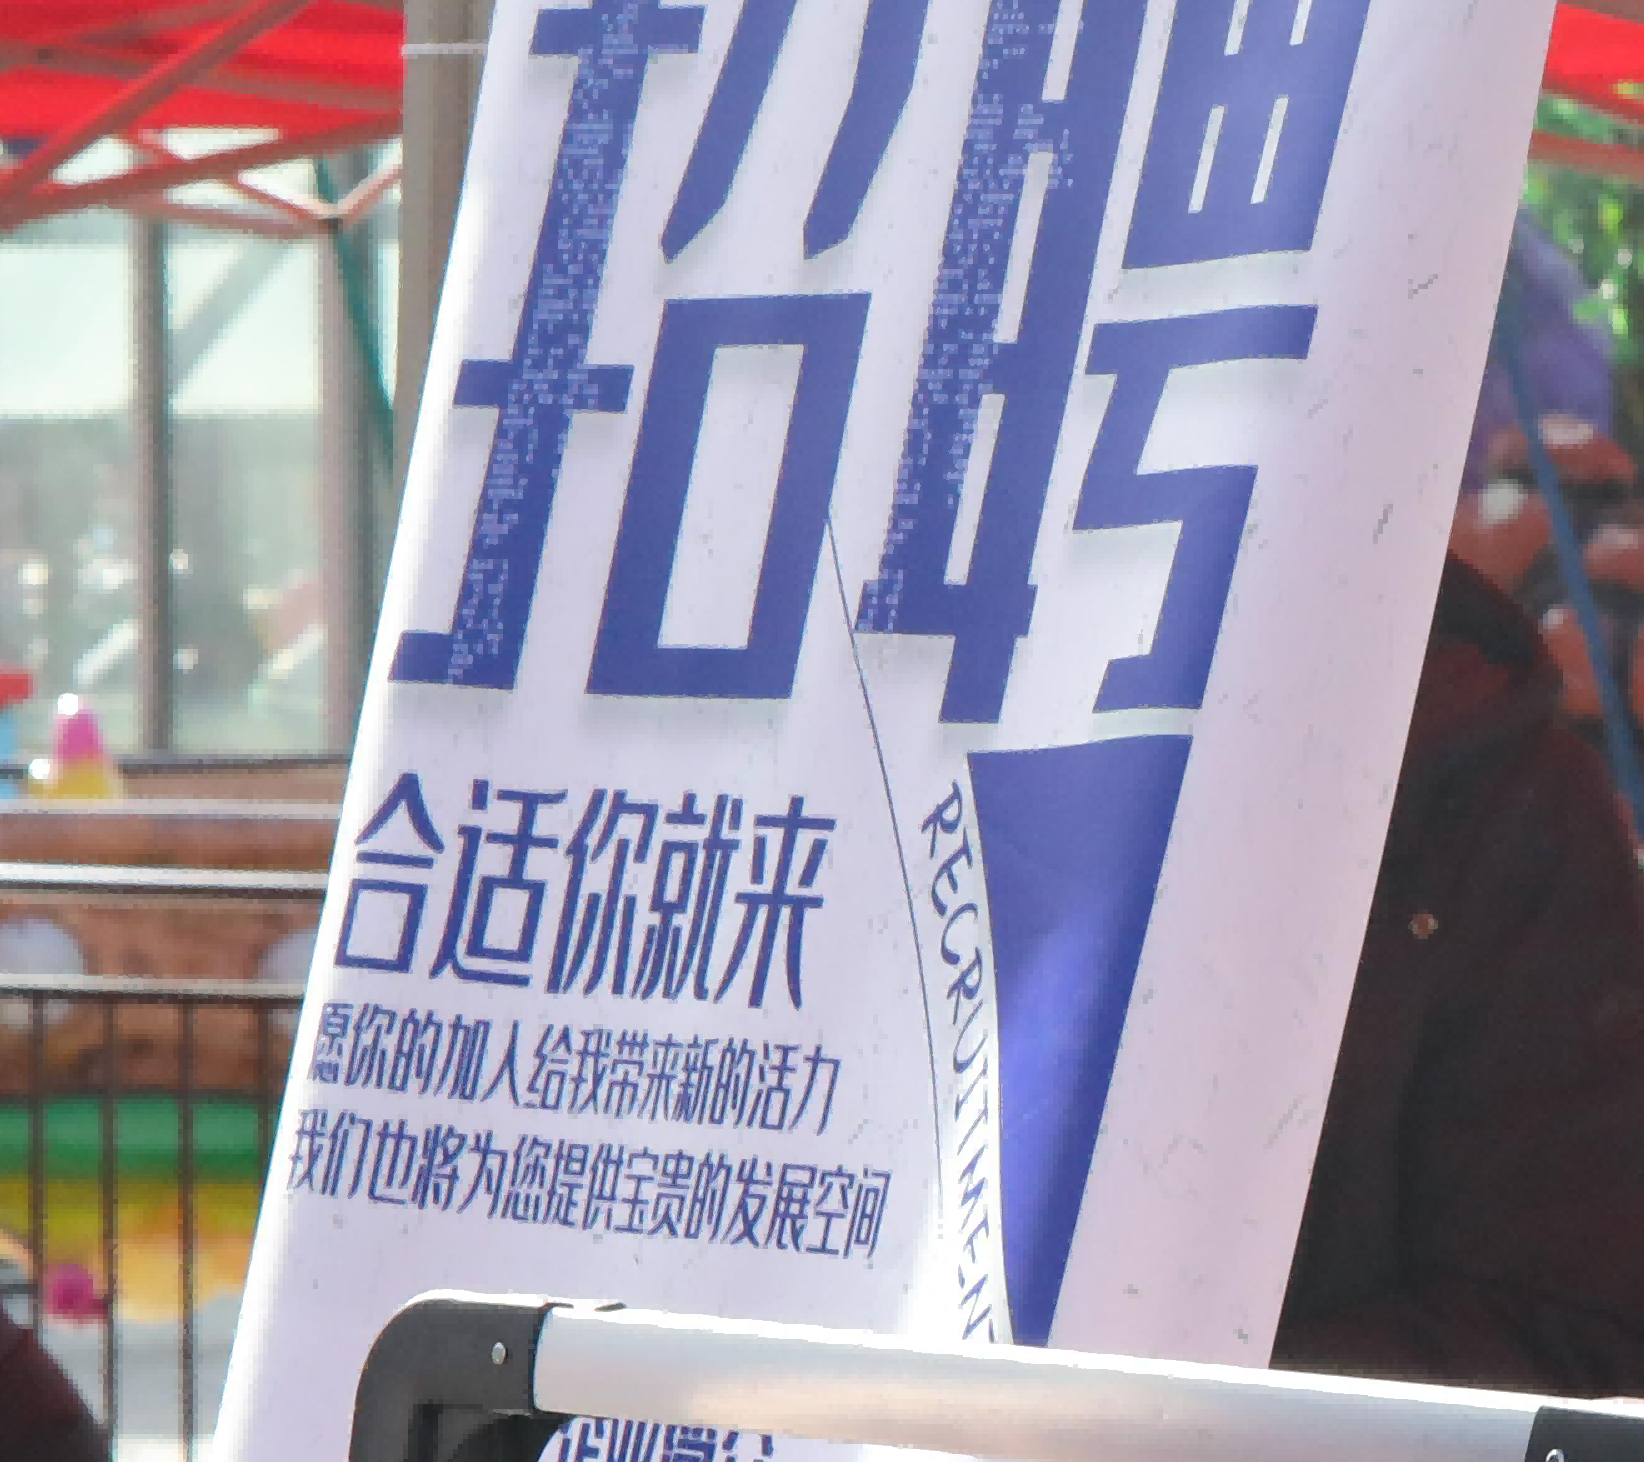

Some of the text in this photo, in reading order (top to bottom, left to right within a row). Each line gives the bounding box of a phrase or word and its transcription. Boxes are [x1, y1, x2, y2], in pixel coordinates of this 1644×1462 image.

[334, 771, 838, 1011] 合适你就来
[286, 1108, 892, 1260] 我们也将为您提供宝贵的发展空间
